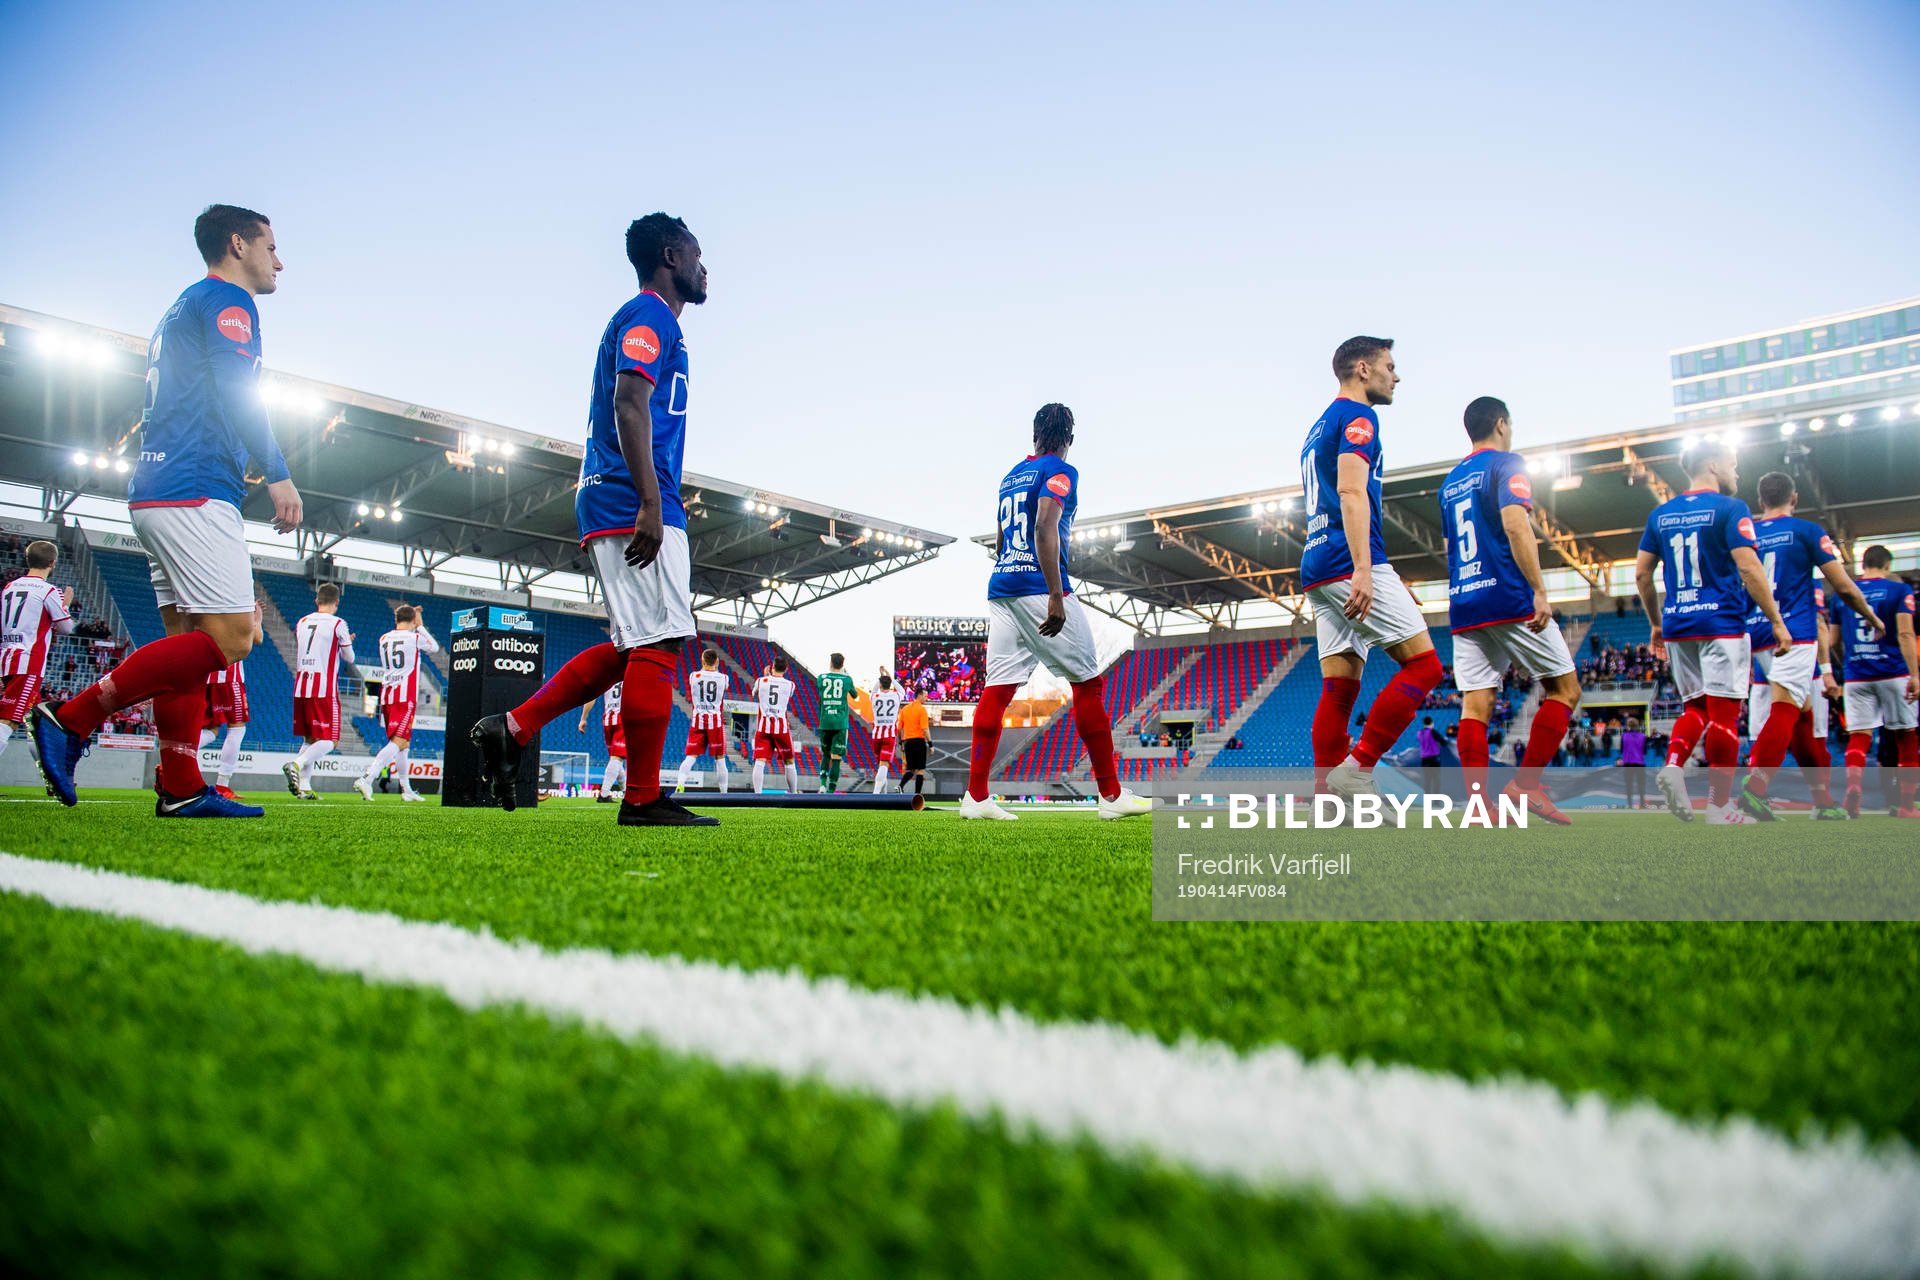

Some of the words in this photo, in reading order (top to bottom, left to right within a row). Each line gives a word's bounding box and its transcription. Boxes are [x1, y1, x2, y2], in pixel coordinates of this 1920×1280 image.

[625, 337, 656, 355] altibox
[420, 410, 441, 423] NRC
[1455, 498, 1478, 562] 5
[1669, 532, 1702, 588] 11
[371, 574, 391, 584] NRC
[469, 588, 486, 598] NRC
[4, 591, 29, 628] 17
[502, 615, 518, 624] ELITE
[307, 624, 318, 655] 7
[453, 637, 480, 653] altibox
[492, 638, 539, 654] altibox
[381, 640, 406, 669] 15
[453, 657, 477, 672] coop
[494, 658, 535, 674] coop
[698, 680, 717, 702] 19
[768, 685, 779, 705] 5
[822, 678, 843, 698] 28
[875, 699, 895, 717] 22
[314, 760, 339, 771] NRC
